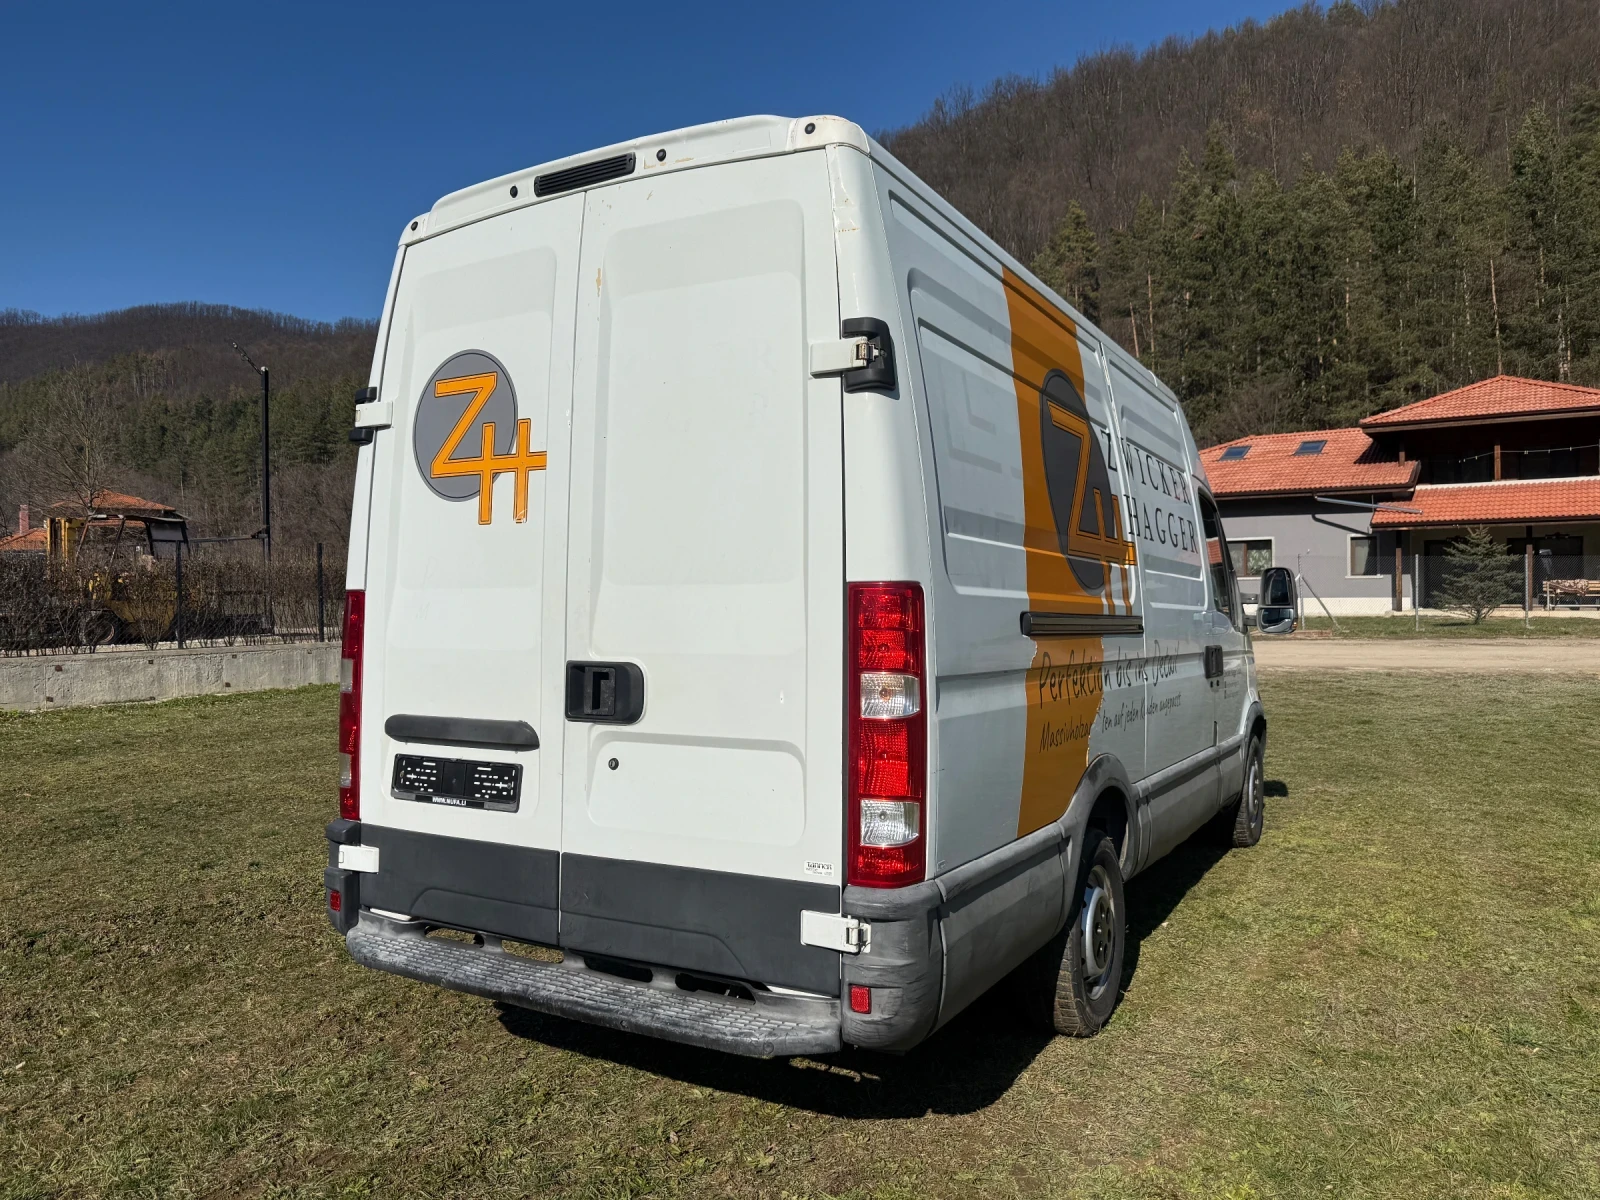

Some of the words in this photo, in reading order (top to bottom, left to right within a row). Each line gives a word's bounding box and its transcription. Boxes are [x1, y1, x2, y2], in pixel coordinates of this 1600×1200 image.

[1101, 430, 1191, 506] ZWICKER
[1124, 494, 1199, 554] HAGGER
[1039, 648, 1112, 709] Perfektion
[1116, 646, 1131, 687] bis
[1152, 639, 1180, 687] Detail
